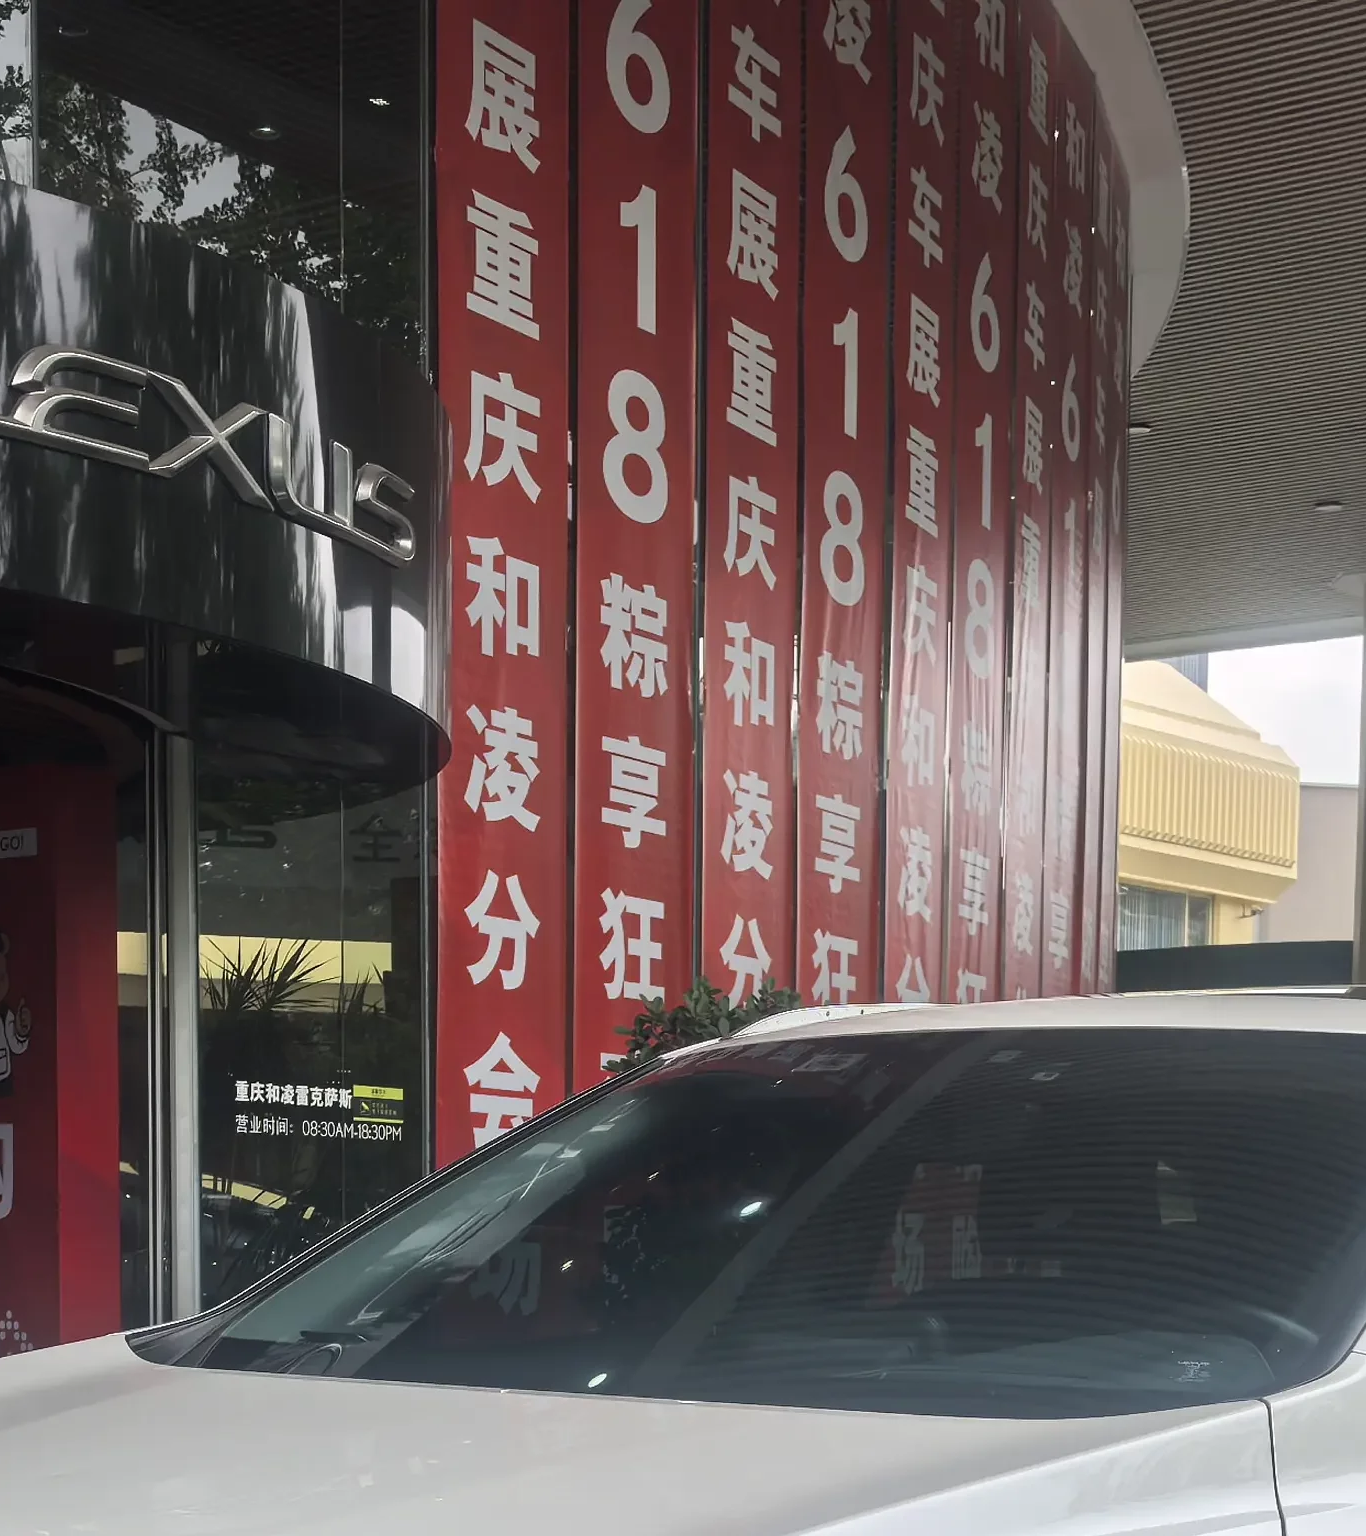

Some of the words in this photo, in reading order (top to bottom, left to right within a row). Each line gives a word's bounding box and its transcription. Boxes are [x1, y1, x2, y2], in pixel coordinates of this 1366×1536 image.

[235, 1080, 353, 1110] 重庆和凌雷克萨斯
